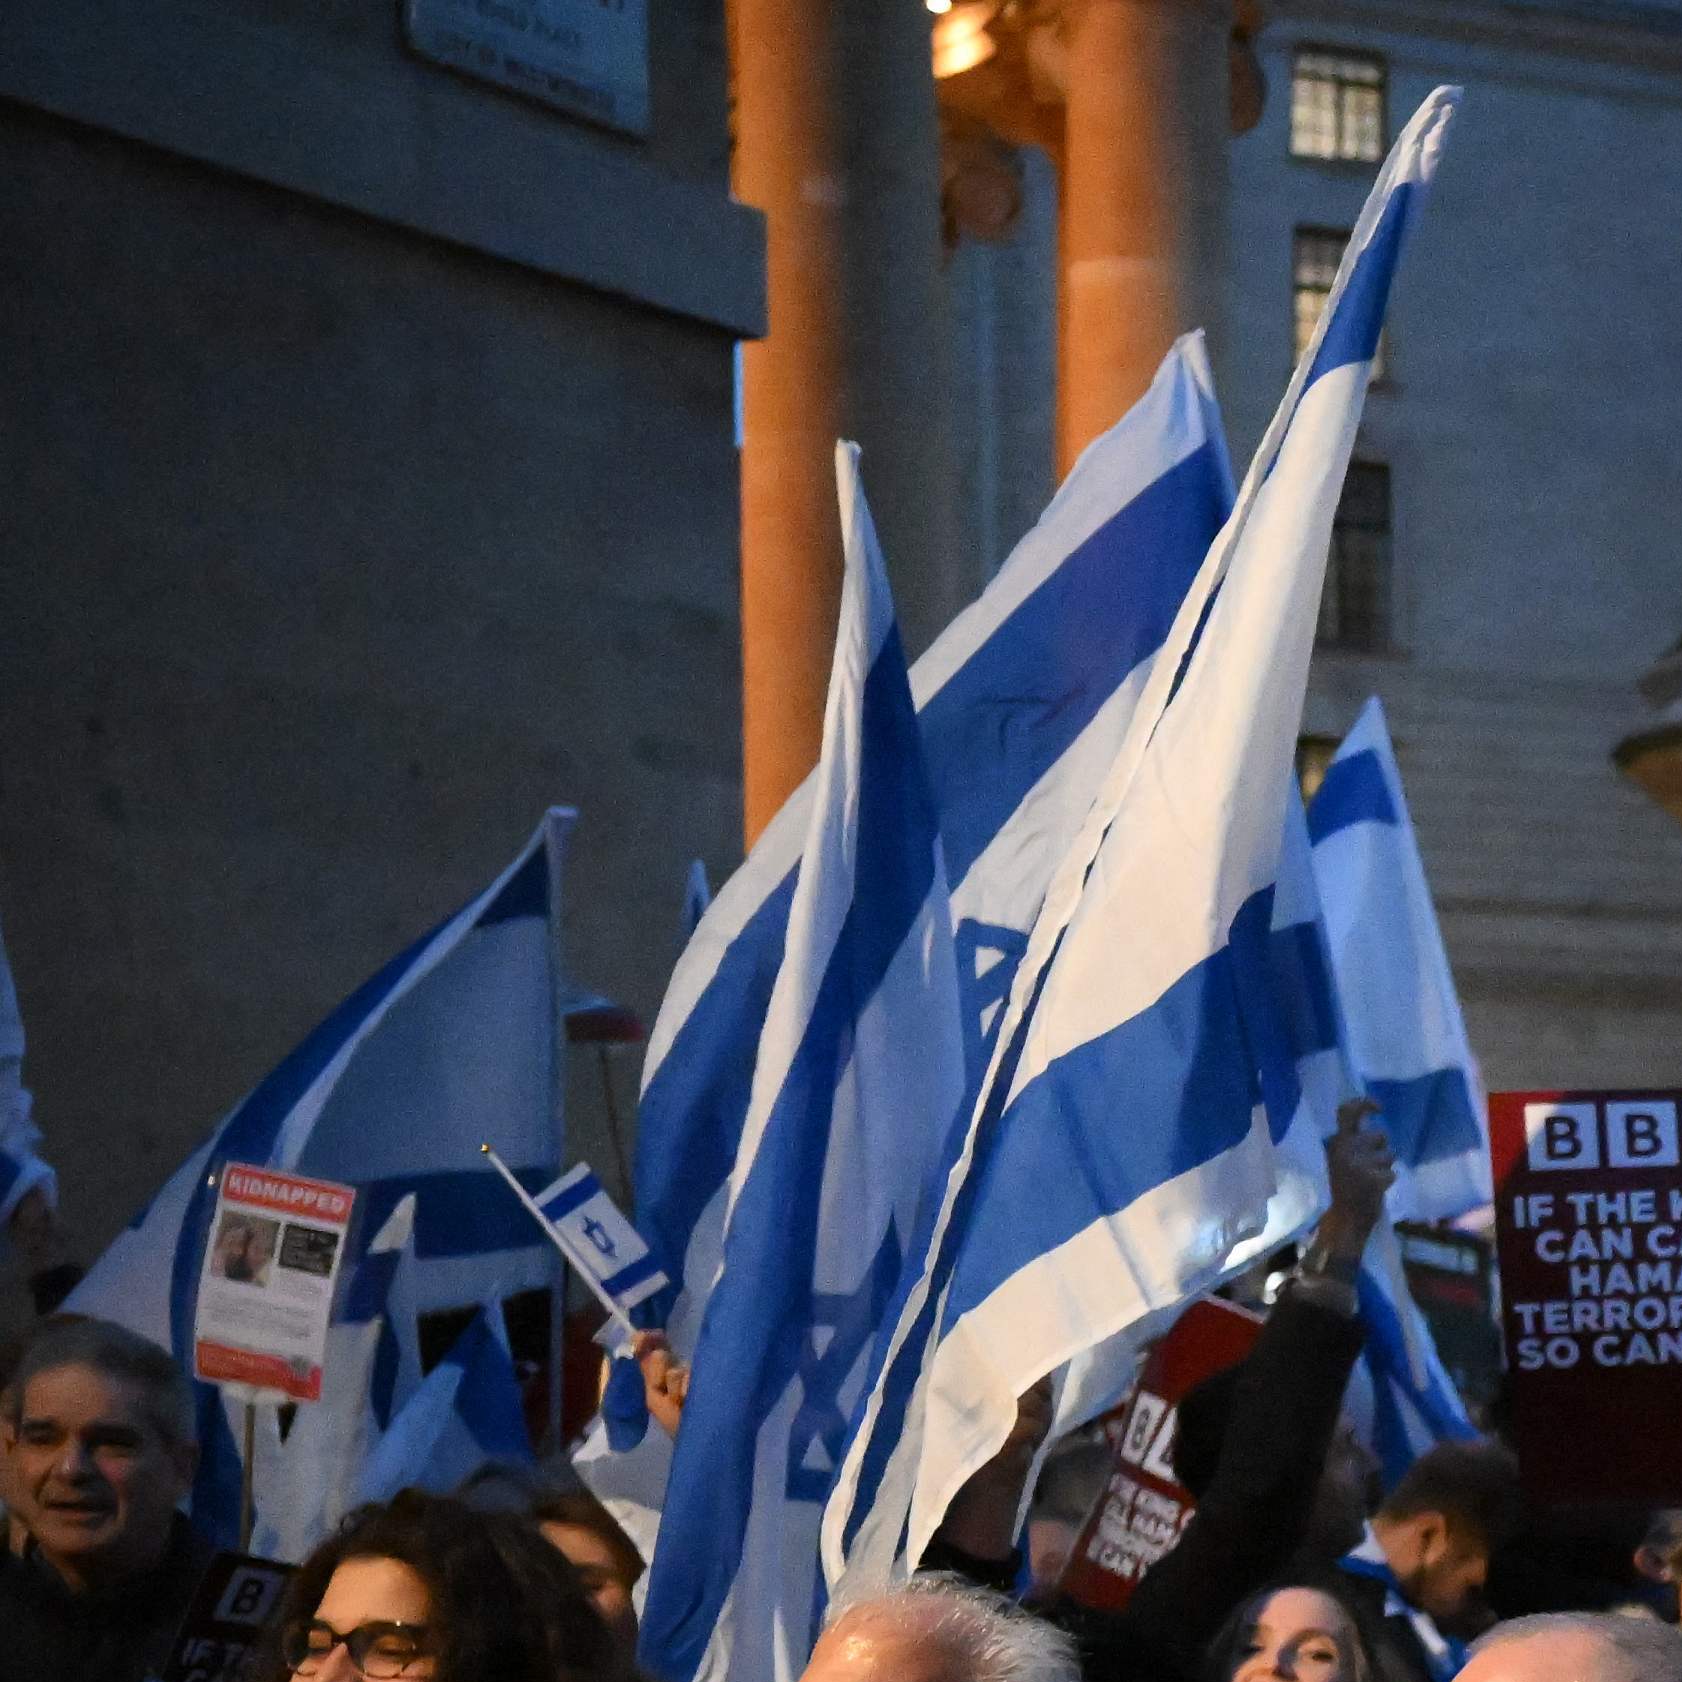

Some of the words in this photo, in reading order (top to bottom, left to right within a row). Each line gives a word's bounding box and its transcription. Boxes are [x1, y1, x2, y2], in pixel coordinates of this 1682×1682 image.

[229, 1172, 346, 1213] KIDNAPPED
[1513, 1194, 1554, 1229] IF
[1565, 1189, 1657, 1226] THE
[1535, 1227, 1634, 1263] CAN
[1517, 1336, 1580, 1371] SO
